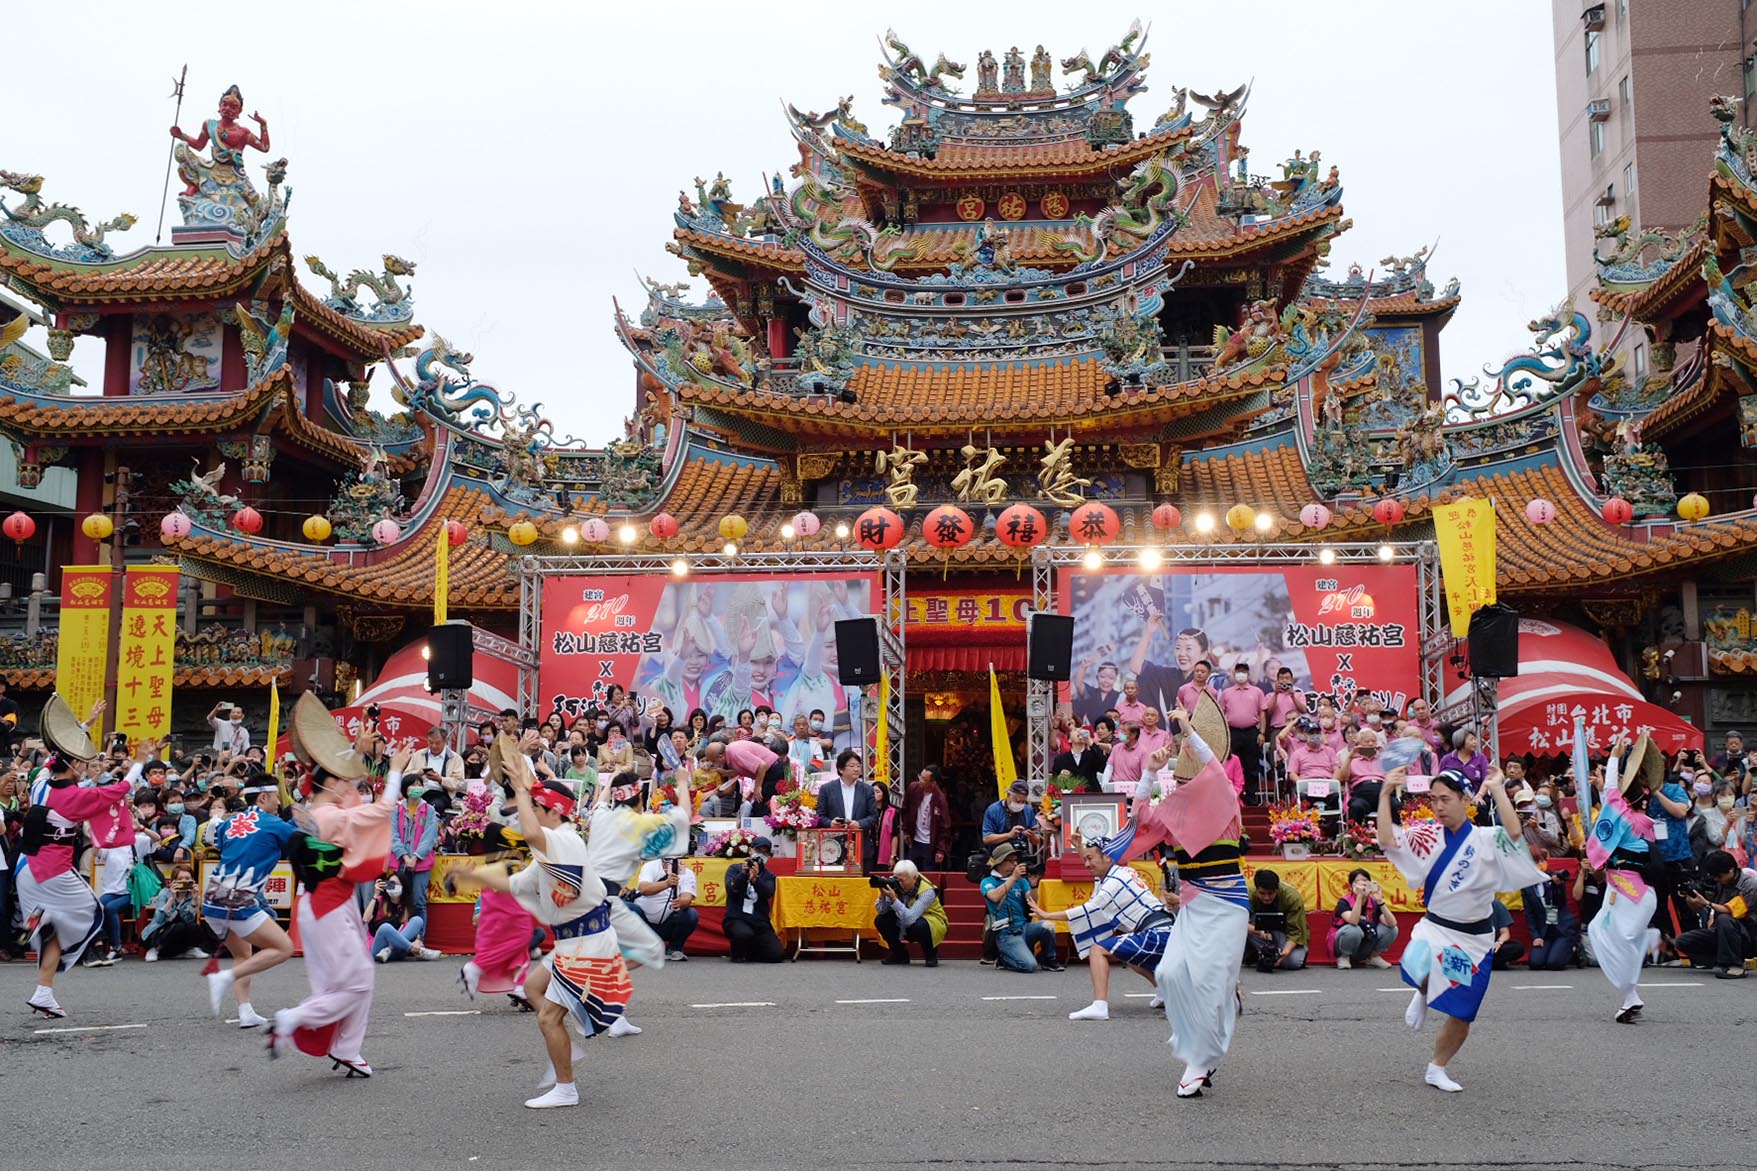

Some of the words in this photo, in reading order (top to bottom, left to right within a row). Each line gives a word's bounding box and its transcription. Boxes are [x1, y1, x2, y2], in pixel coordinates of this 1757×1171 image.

[860, 517, 890, 544] 財
[934, 514, 966, 543] 發
[1007, 513, 1038, 543] 禧
[1077, 511, 1108, 538] 恭
[583, 590, 604, 601] 建宮
[1315, 579, 1338, 591] 建宮
[584, 594, 629, 624] 270
[1318, 584, 1365, 616] 270
[553, 631, 664, 655] 松山慈祐宮
[1287, 623, 1406, 648] 松山慈祐宮
[1570, 704, 1634, 726] 台北市
[703, 881, 721, 903] 宮
[811, 883, 841, 897] 松山
[1451, 956, 1471, 976] 新
